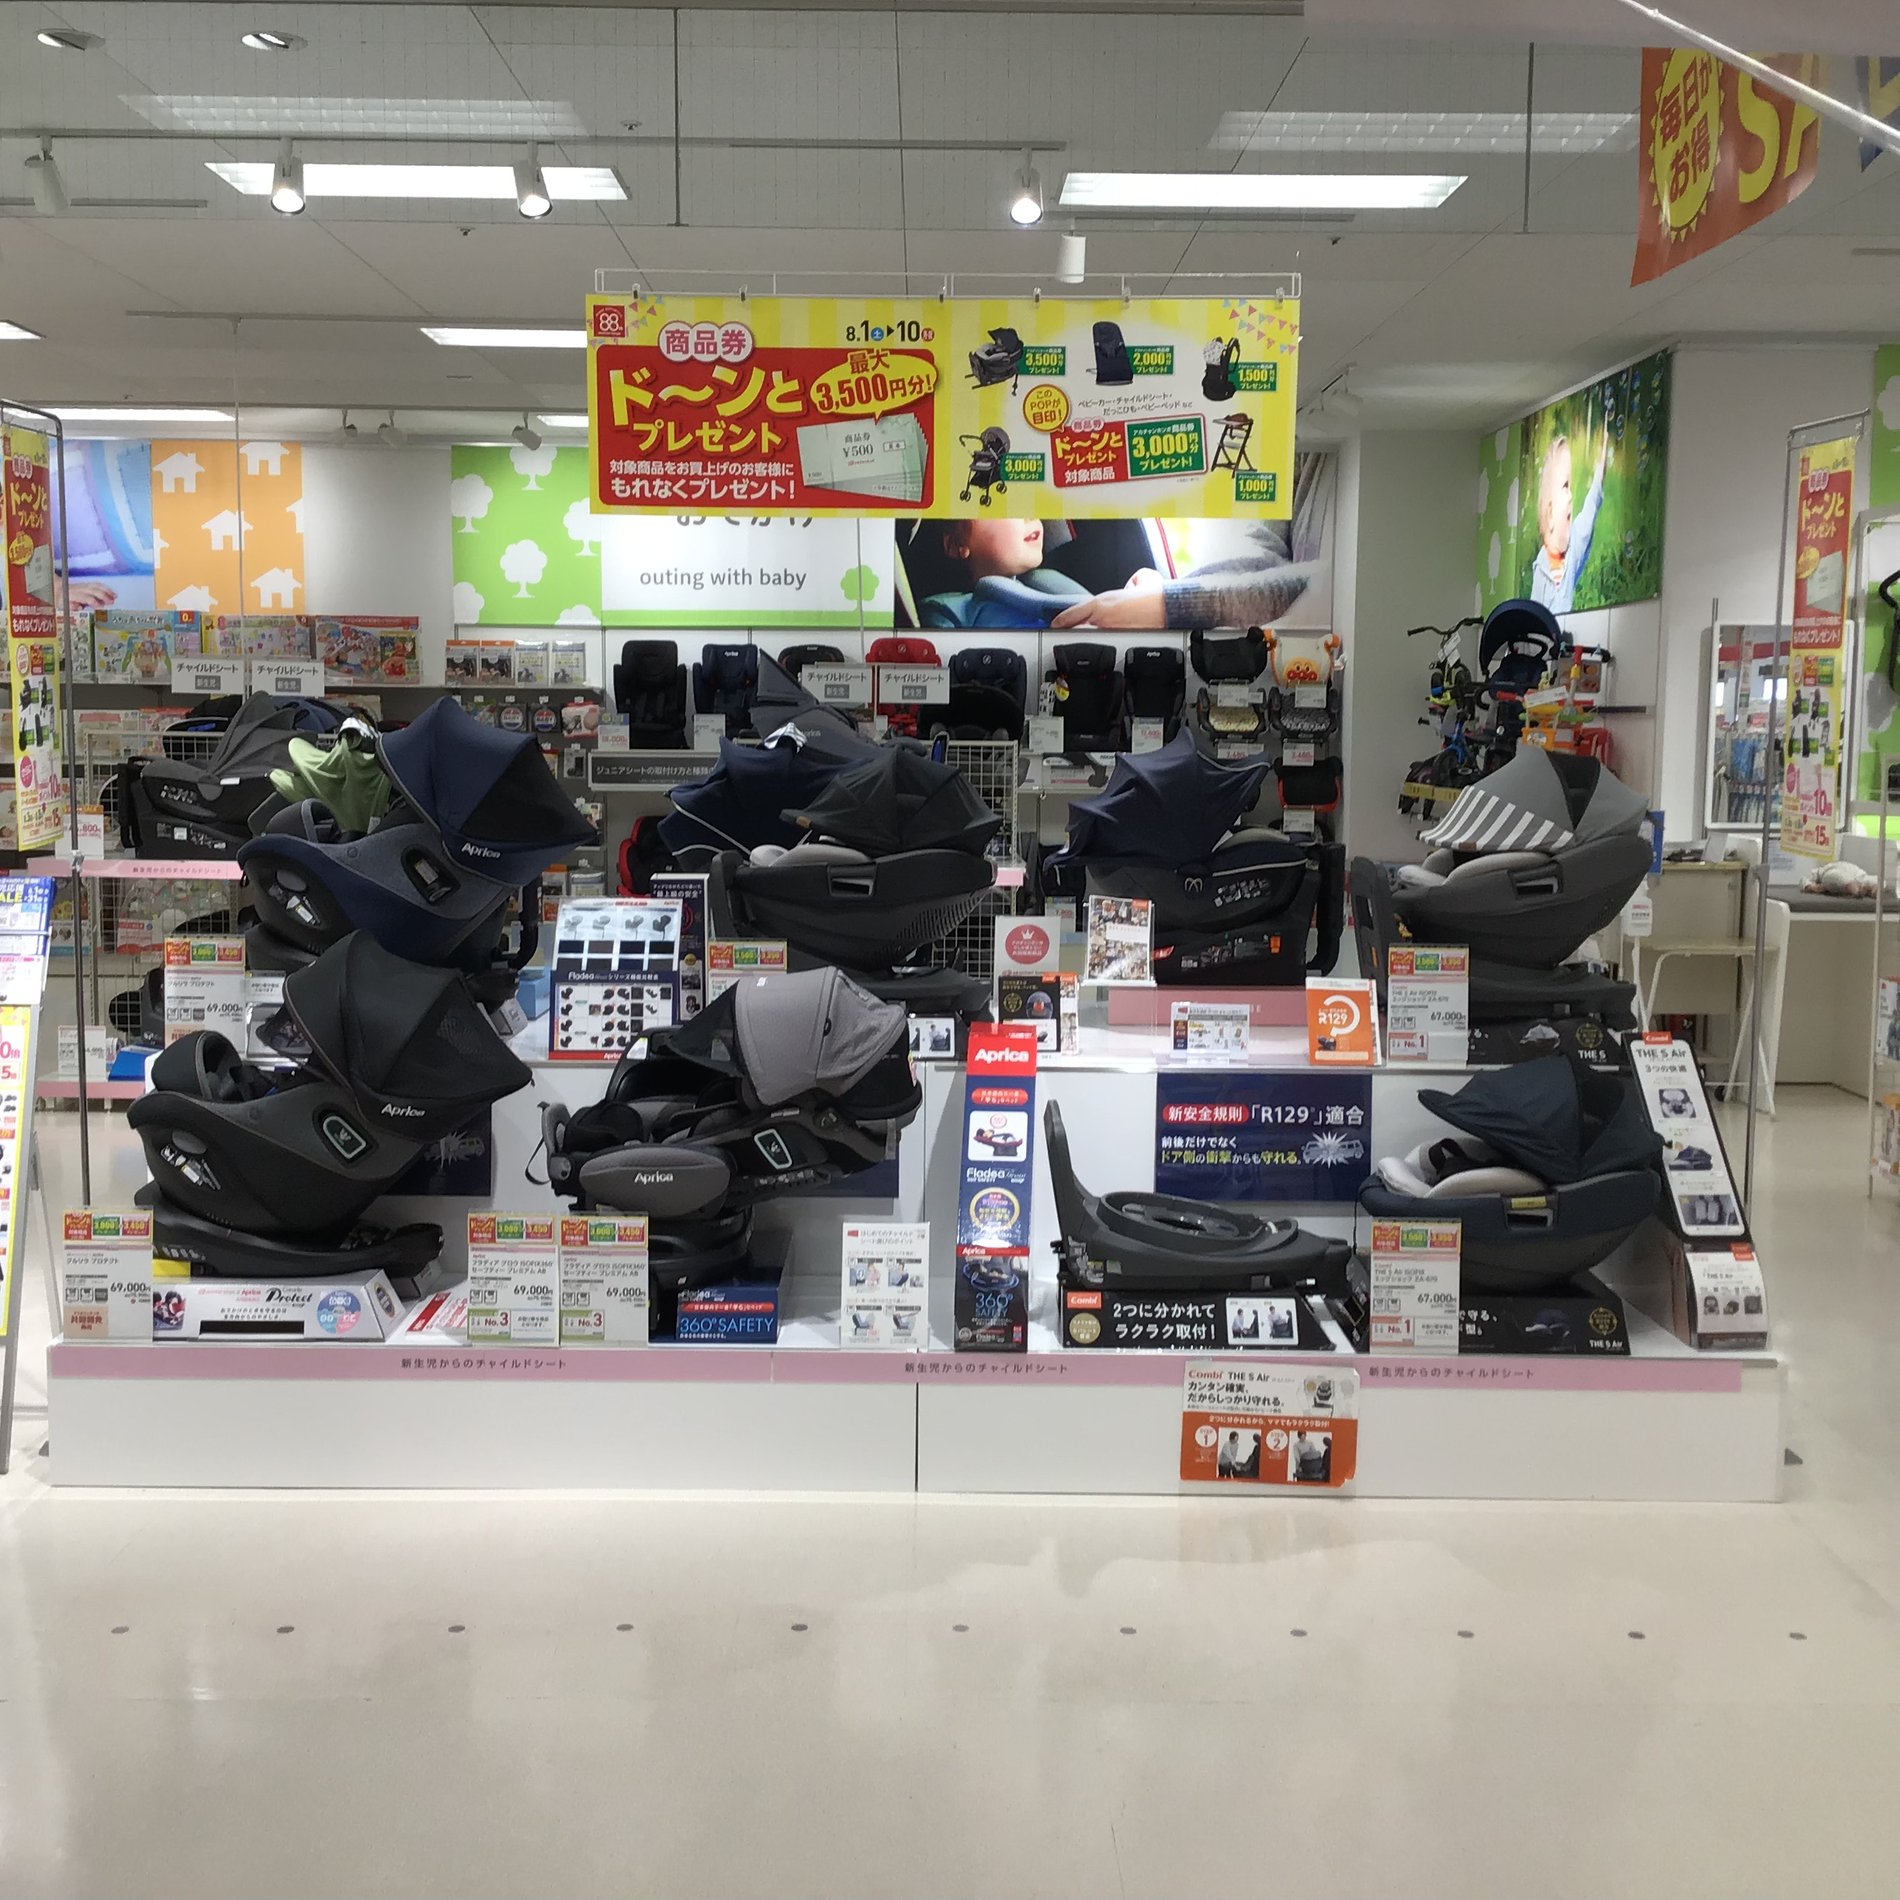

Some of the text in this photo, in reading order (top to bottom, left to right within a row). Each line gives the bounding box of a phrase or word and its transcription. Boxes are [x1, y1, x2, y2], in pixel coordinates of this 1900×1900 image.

[1669, 113, 1711, 204] お得
[664, 329, 748, 356] 商品券
[849, 350, 891, 373] 最大
[816, 373, 933, 413] 3,500円分!
[1036, 390, 1053, 398] この
[1030, 398, 1061, 411] POPが
[1032, 410, 1062, 425] 目印!
[1073, 419, 1102, 431] 商品券
[633, 418, 782, 454] プレゼント
[1064, 450, 1117, 467] プレゼント
[1139, 457, 1193, 472] プレゼント!
[609, 460, 795, 477] 対象商品をお買上げのお客様に
[1064, 466, 1116, 484] 対象商品
[610, 477, 796, 500] もれなくプレゼント!
[640, 568, 807, 591] outing with baby
[176, 662, 239, 675] チャイルドシート
[256, 663, 319, 677] チャイルドシート
[807, 672, 867, 683] チャイルドシート
[884, 673, 945, 684] チャイルドシート
[461, 842, 501, 858] Aprica
[568, 971, 595, 981] Fladea
[206, 1003, 243, 1013] 69,000円
[1318, 1012, 1348, 1025] R129
[974, 1047, 1030, 1064] Aprica
[1577, 1050, 1598, 1060] THE
[380, 1103, 426, 1118] Aprica
[1168, 1105, 1243, 1123] 新安全規則
[1161, 1136, 1237, 1149] 前後だけでなく
[1161, 1149, 1302, 1165] ドア側の衝撃からも守れる。
[634, 1171, 674, 1184] Aprica
[966, 1167, 1005, 1179] Fladea
[110, 1282, 151, 1293] 69,000円
[513, 1285, 553, 1296] 69,000円
[606, 1287, 646, 1298] 69,000円
[265, 1287, 313, 1303] Protect
[1070, 1295, 1098, 1305] Combi
[1417, 1293, 1457, 1303] 67,000円
[1112, 1303, 1216, 1319] 2つに分かれて
[484, 1312, 509, 1327] No. 3
[578, 1313, 603, 1328] No. 3
[1404, 1319, 1411, 1334] 1
[1115, 1324, 1216, 1341] ラクラク取付!
[401, 1357, 566, 1369] 新生児からのチャイルドシート
[904, 1362, 1068, 1374] 新生児からのチャイルドシート
[1188, 1370, 1270, 1382] Combi THE S Air
[1369, 1367, 1535, 1378] 新生児からのチャイルドシート
[1188, 1381, 1249, 1394] カンタン確実、
[1187, 1392, 1285, 1407] だからしっかり守れる。
[1273, 1438, 1282, 1449] 2
